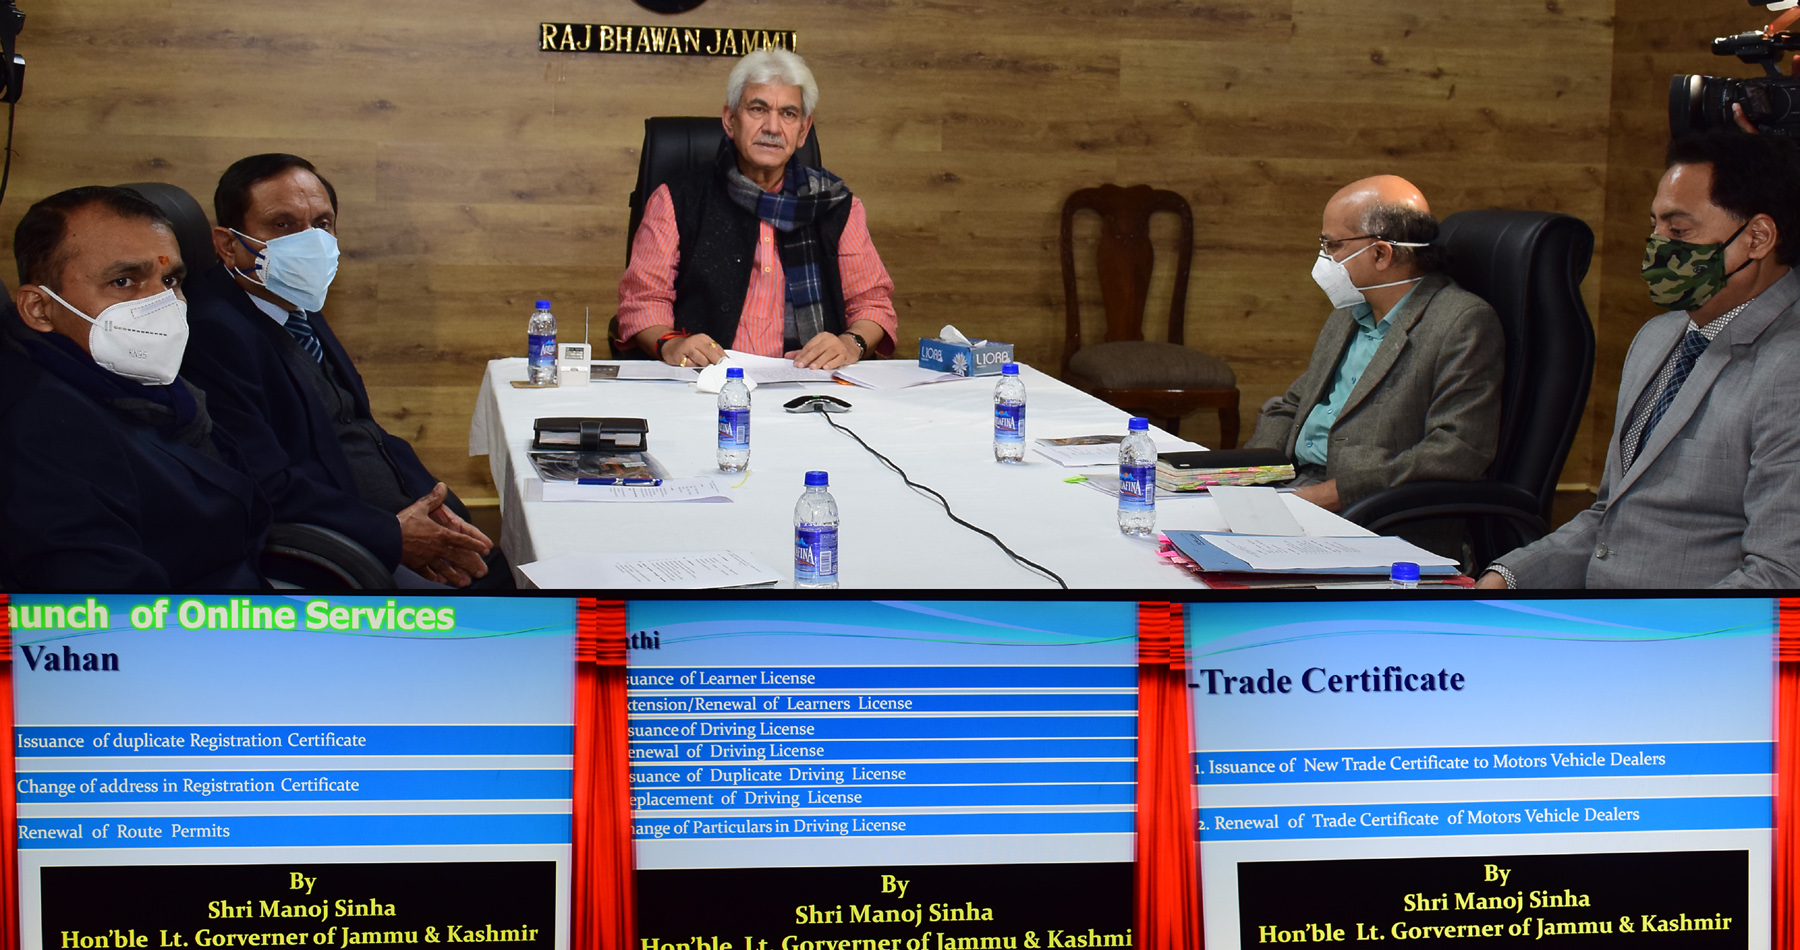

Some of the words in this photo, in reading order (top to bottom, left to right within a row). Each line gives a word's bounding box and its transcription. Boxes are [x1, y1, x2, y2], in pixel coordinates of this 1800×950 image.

[542, 24, 592, 51] RAJ
[600, 25, 701, 54] BHAWAN
[706, 29, 797, 55] JAMMU
[130, 598, 169, 629] of
[178, 598, 296, 630] Online
[305, 599, 456, 630] Services
[20, 645, 120, 671] Vahan
[680, 671, 696, 685] of
[700, 672, 756, 684] Learner
[761, 672, 815, 684] License
[1301, 666, 1465, 693] Certificate
[764, 696, 779, 710] of
[788, 697, 850, 710] Learners
[859, 697, 912, 709] License
[19, 735, 84, 747] Issuance
[93, 733, 110, 747] of
[113, 733, 184, 751] duplicate
[191, 733, 282, 751] Registration
[288, 732, 366, 746] Certificate
[682, 722, 697, 736] of
[701, 722, 757, 739] Driving
[761, 723, 814, 735] License
[686, 744, 703, 758] of
[711, 745, 766, 760] Driving
[770, 744, 824, 756] License
[1195, 764, 1205, 775] 1.
[1209, 760, 1275, 773] Issuance
[1279, 758, 1296, 772] of
[1304, 758, 1338, 771] New
[1342, 756, 1385, 770] Trade
[1390, 755, 1468, 770] Certificate
[1474, 757, 1488, 768] to
[1494, 755, 1547, 768] Motors
[1551, 752, 1605, 766] Vehicle
[1611, 751, 1665, 765] Dealers
[686, 768, 703, 782] of
[711, 768, 781, 784] Duplicate
[789, 768, 844, 783] Driving
[853, 767, 906, 780] License
[18, 779, 75, 797] Change
[80, 778, 97, 793] of
[100, 779, 158, 792] address
[164, 779, 177, 792] in
[183, 778, 274, 796] Registration
[281, 777, 359, 791] Certificate
[721, 791, 737, 804] of
[745, 791, 799, 806] Driving
[808, 791, 861, 803] License
[674, 820, 690, 834] of
[693, 820, 772, 833] Particulars
[776, 820, 789, 832] in
[794, 819, 848, 835] Driving
[853, 819, 906, 831] License
[1197, 820, 1210, 831] 2.
[1215, 814, 1278, 829] Renewal
[1288, 813, 1305, 828] of
[1312, 813, 1356, 827] Trade
[1360, 811, 1438, 826] Certificate
[1448, 810, 1464, 824] of
[1468, 811, 1521, 824] Motors
[1525, 808, 1579, 822] Vehicle
[1585, 807, 1639, 821] Dealers
[19, 824, 82, 838] Renewal
[92, 824, 109, 838] of
[118, 825, 162, 838] Route
[172, 824, 229, 837] Permits
[290, 872, 316, 894] By
[1484, 864, 1511, 886] By
[881, 875, 909, 898] By
[209, 900, 253, 918] Shri
[259, 900, 328, 921] Manoj
[335, 898, 396, 917] Sinha
[1404, 893, 1448, 911] Shri
[1455, 891, 1522, 913] Manoj
[1530, 889, 1590, 908] Sinha
[796, 905, 843, 924] Shri
[850, 904, 921, 927] Manoj
[930, 902, 993, 921] Sinha
[160, 930, 188, 947] Lt.
[195, 929, 308, 946] Gorverner
[313, 927, 337, 944] of
[342, 927, 418, 945] Jammu
[425, 926, 440, 943] &
[447, 924, 538, 942] Kashmir
[1356, 923, 1384, 940] Lt.
[1392, 922, 1503, 939] Gorverner
[1509, 918, 1532, 936] of
[1537, 918, 1613, 938] Jammu
[1619, 916, 1635, 933] &
[1641, 913, 1732, 932] Kashmir
[906, 932, 932, 950] of
[937, 932, 1017, 950] Jammu
[1024, 931, 1041, 949] &
[1048, 929, 1133, 947] Kashmi
